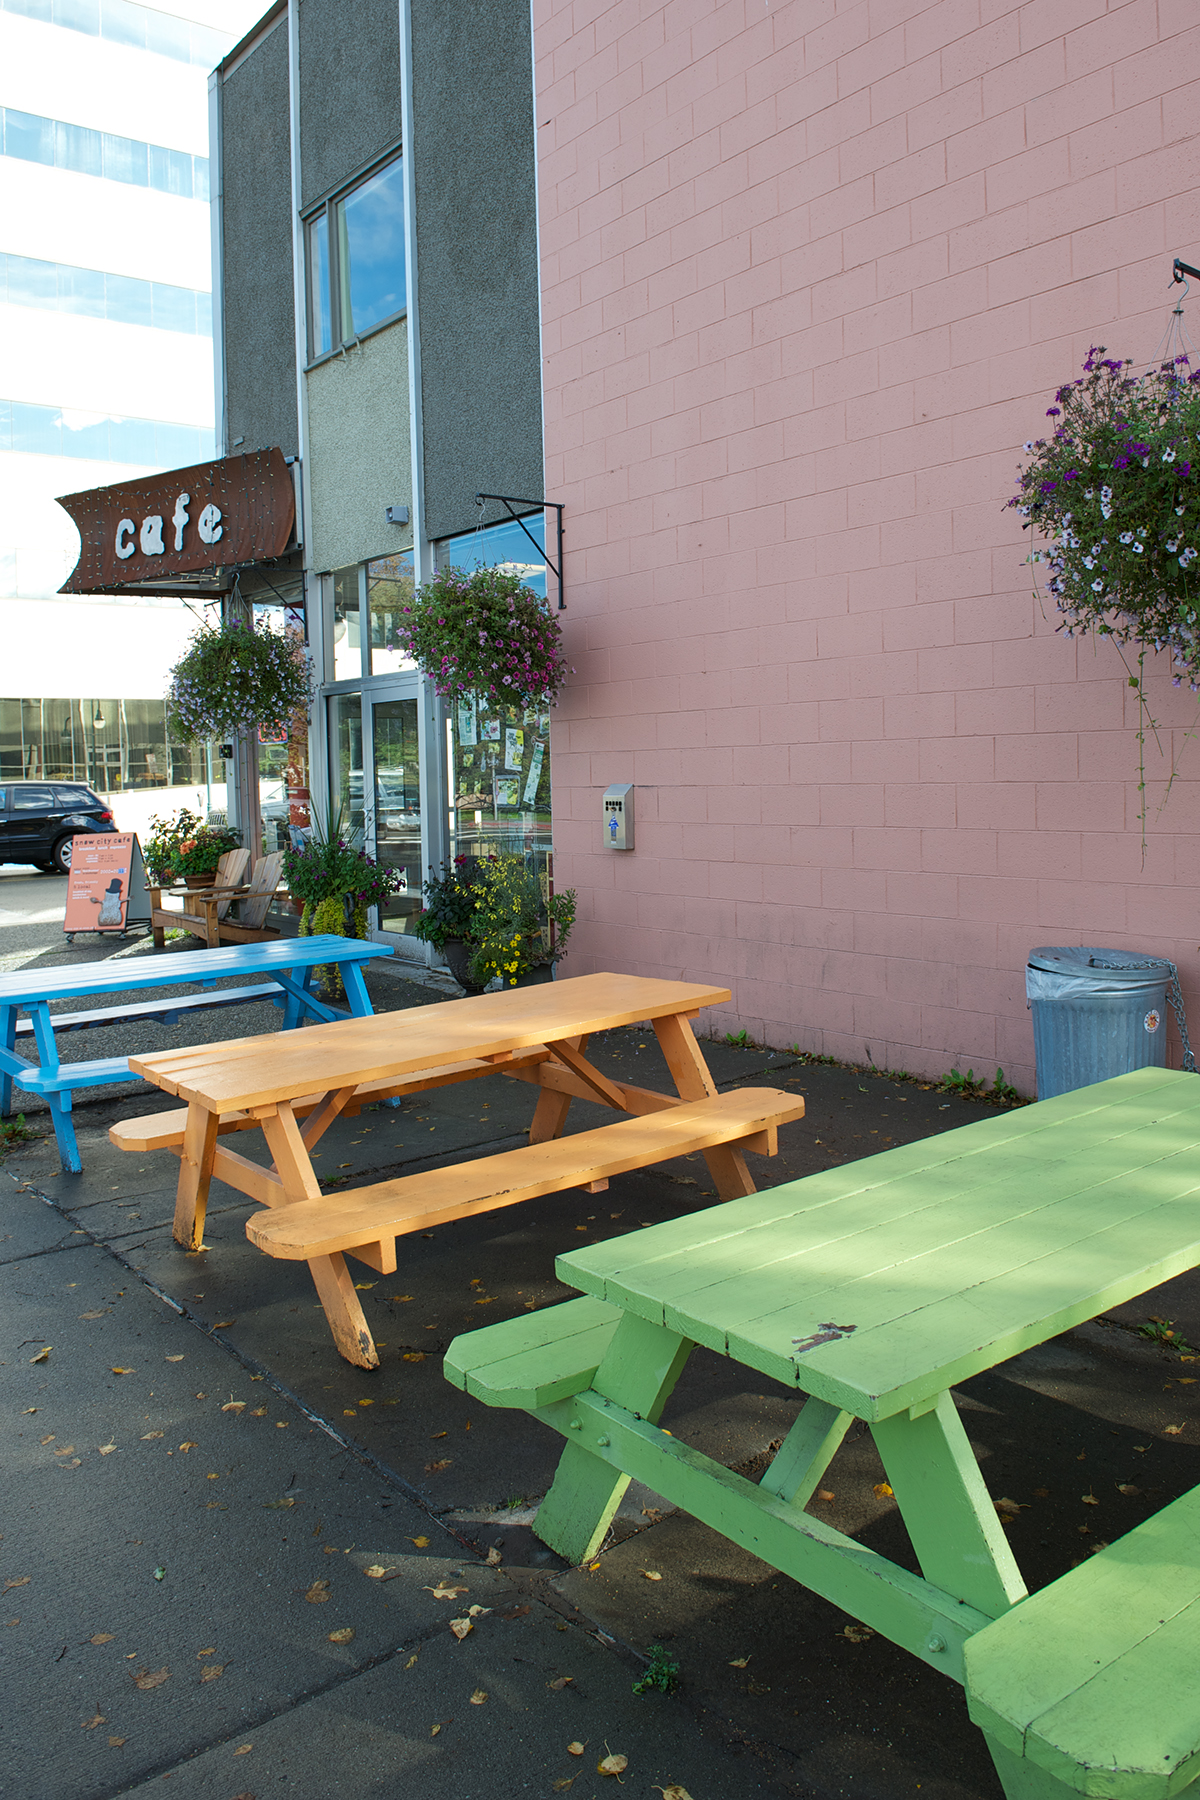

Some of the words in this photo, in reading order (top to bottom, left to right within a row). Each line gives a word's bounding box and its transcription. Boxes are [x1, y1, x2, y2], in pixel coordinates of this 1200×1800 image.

[115, 493, 223, 559] cafe
[96, 837, 112, 845] city
[113, 836, 131, 844] cafe
